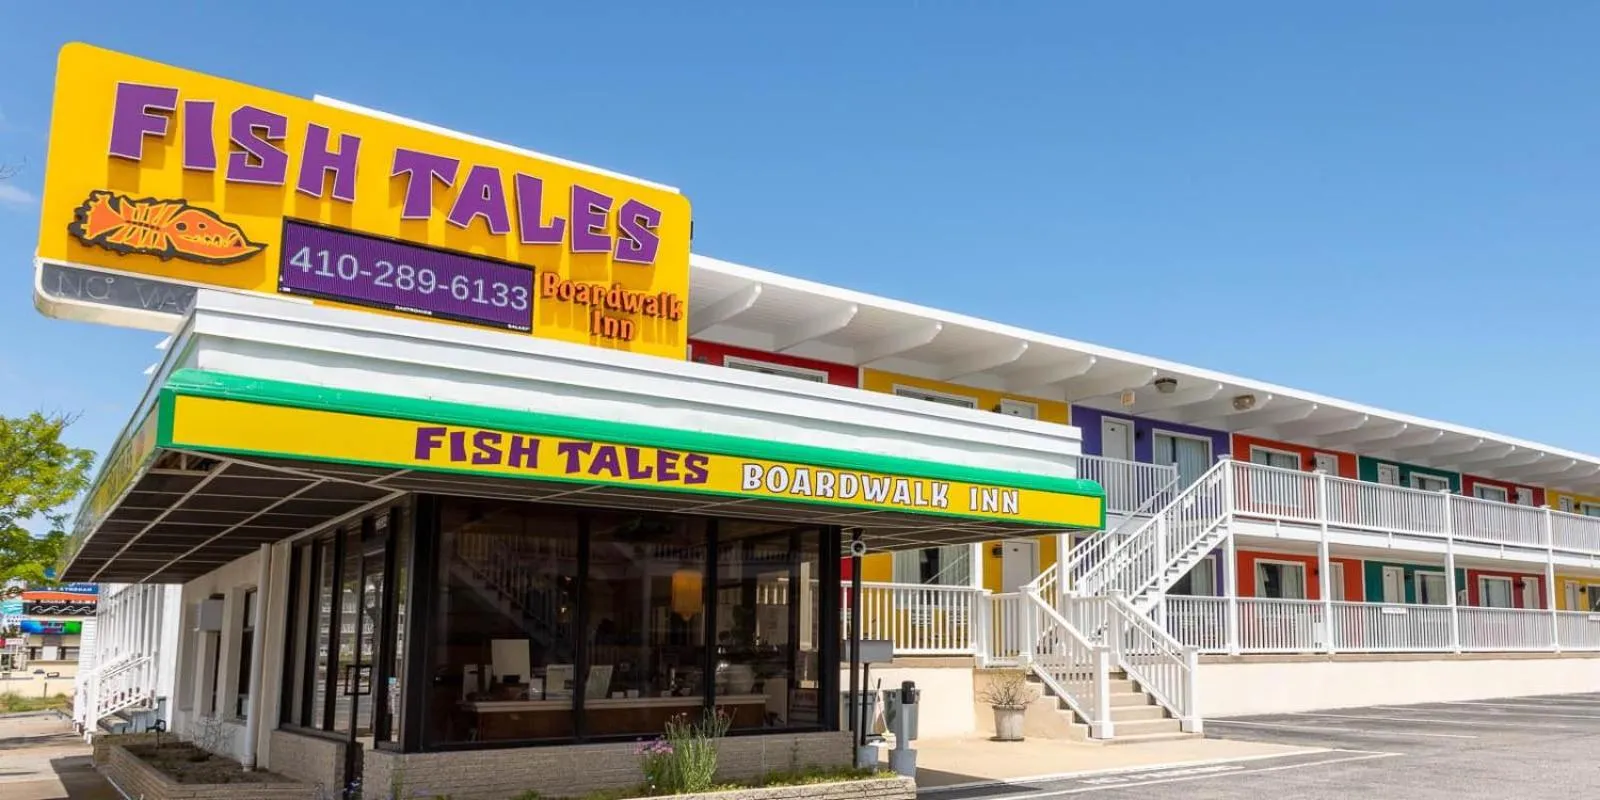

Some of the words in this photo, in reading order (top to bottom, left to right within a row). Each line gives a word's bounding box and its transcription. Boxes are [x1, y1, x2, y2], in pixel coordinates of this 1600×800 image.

[109, 81, 361, 202] FISH
[391, 148, 662, 265] TALES
[56, 270, 115, 301] NO
[289, 246, 529, 311] 410-289-6133
[541, 271, 684, 321] Boardwalk
[591, 308, 635, 341] Inn
[415, 427, 538, 468] FISH
[559, 442, 708, 484] TALES
[741, 462, 950, 510] BOARDWALK
[968, 486, 1020, 516] INN
